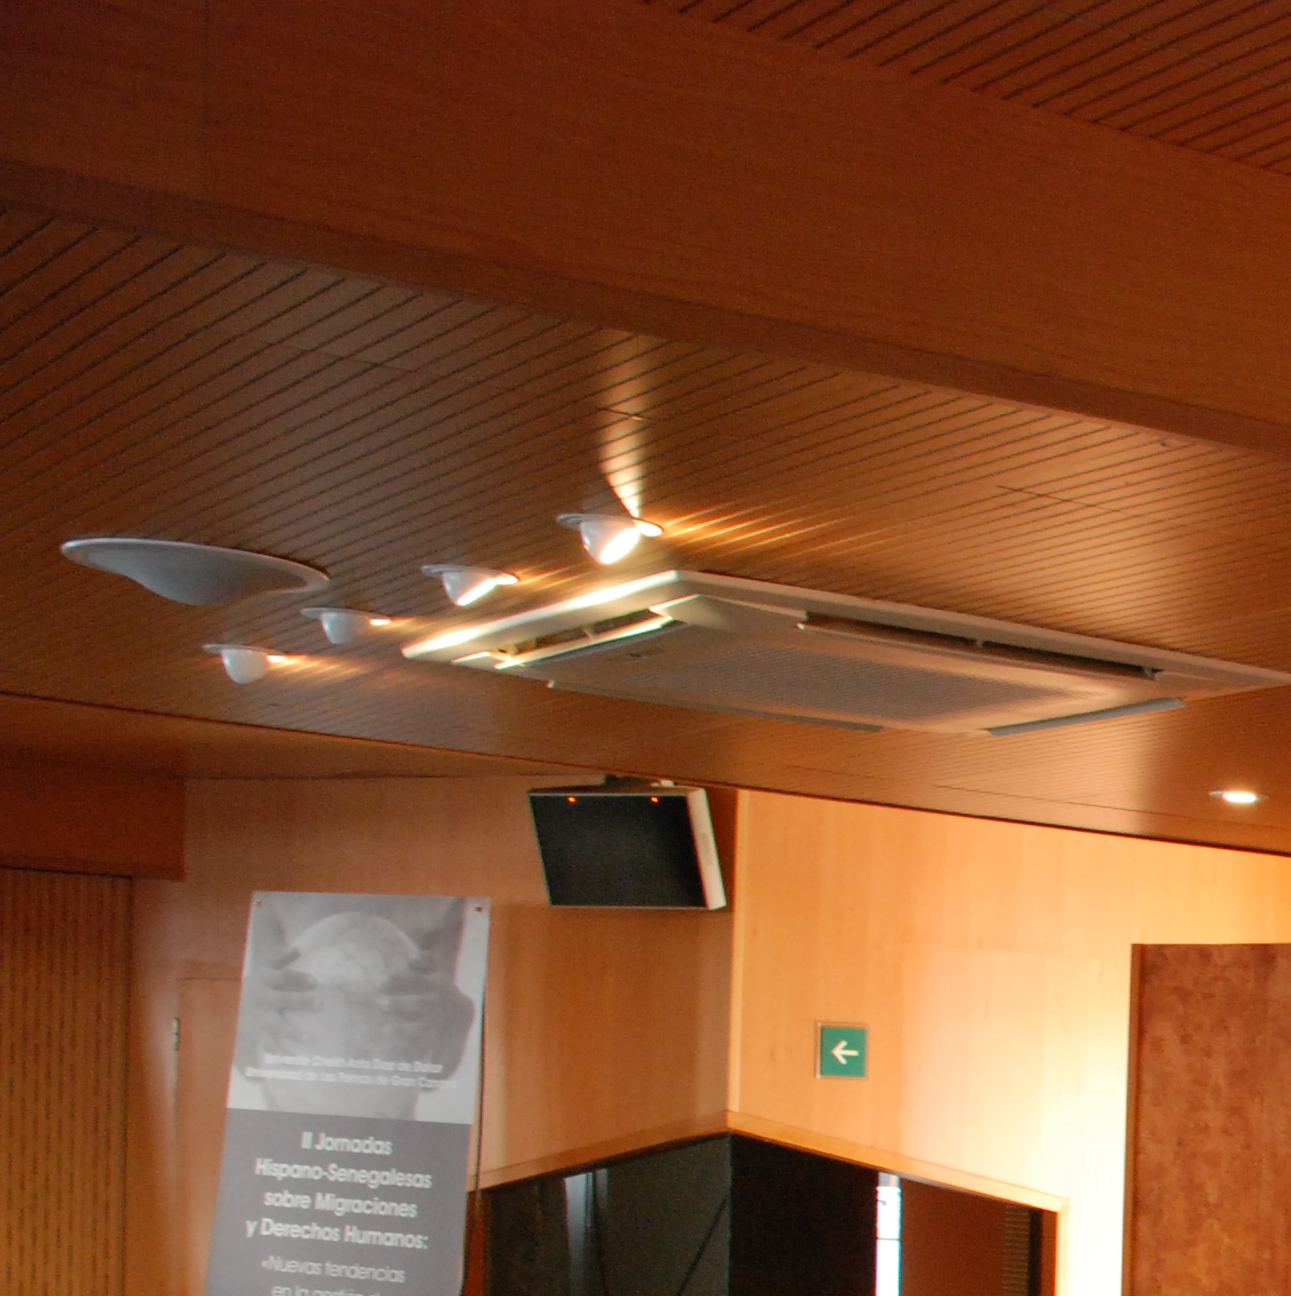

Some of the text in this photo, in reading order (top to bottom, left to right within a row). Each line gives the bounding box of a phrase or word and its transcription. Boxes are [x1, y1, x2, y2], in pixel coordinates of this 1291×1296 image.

[315, 1132, 393, 1156] Jornadas
[255, 1158, 432, 1189] Hispano-Senegalesas
[263, 1190, 418, 1218] sobre Migraciones
[245, 1217, 428, 1250] y Derechos Humanos:
[324, 1259, 406, 1283] tendencias
